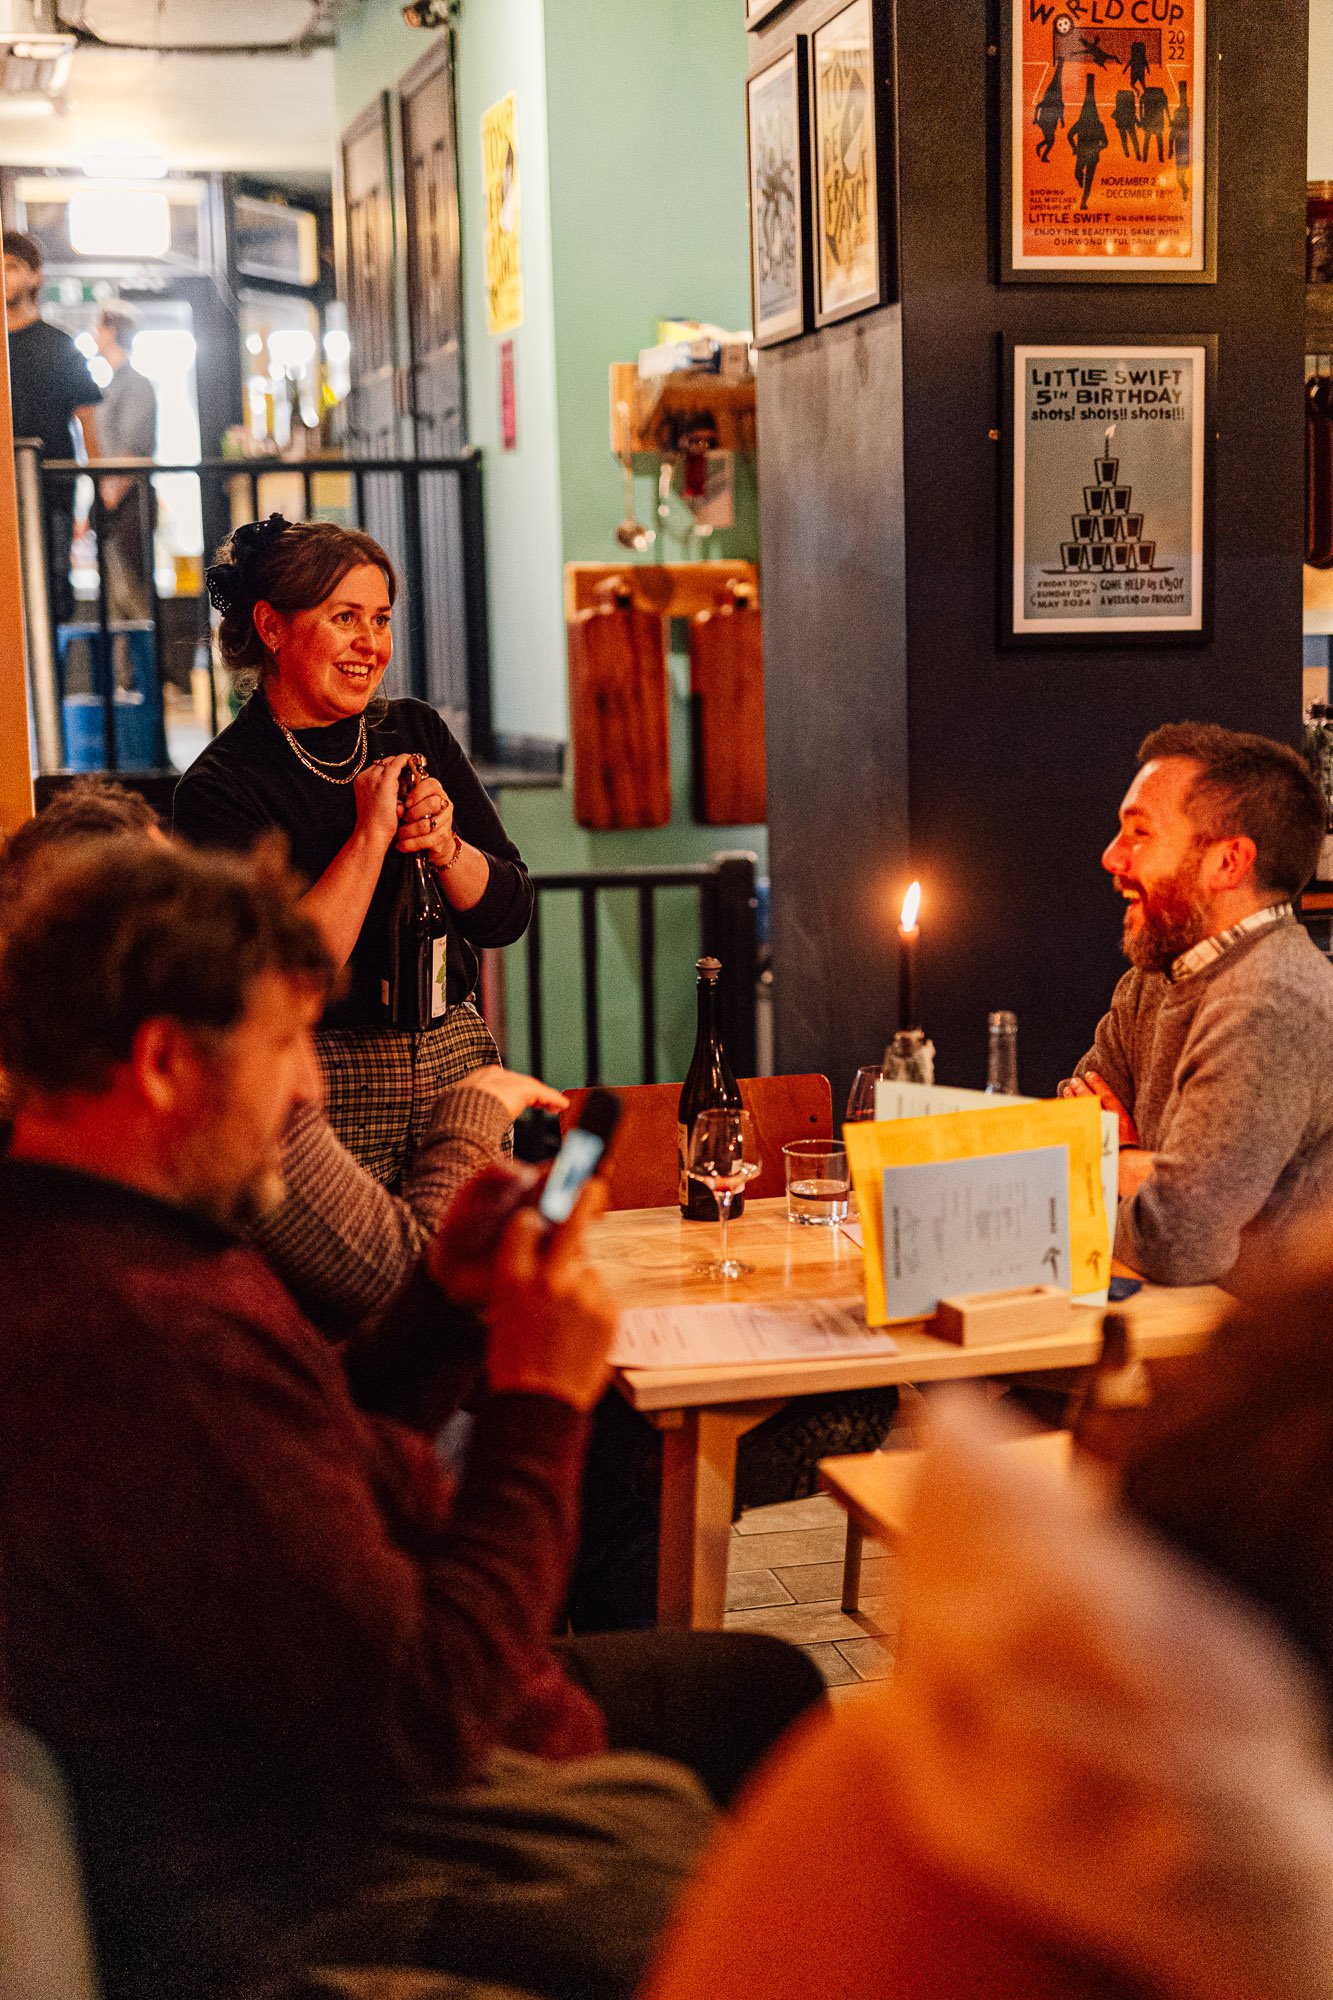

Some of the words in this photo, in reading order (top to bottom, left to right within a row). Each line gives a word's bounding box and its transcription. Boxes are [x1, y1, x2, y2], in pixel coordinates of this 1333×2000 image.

[1131, 0, 1184, 25] CUP
[1168, 31, 1185, 44] 20
[1168, 46, 1185, 60] 22
[1101, 176, 1150, 187] NOVEMBER
[1106, 189, 1153, 199] DECEMBER
[1029, 213, 1069, 223] LITTLE
[1073, 213, 1111, 223] SWIFT
[1034, 228, 1061, 236] ENJOY
[1064, 228, 1079, 236] THE
[1082, 228, 1128, 236] BEAUTIFUL
[1131, 228, 1155, 236] GAME
[1157, 228, 1180, 236] WITH
[1053, 238, 1073, 246] OUR
[1032, 367, 1108, 387] LITTLE
[1114, 369, 1182, 386] SWIFT
[1076, 387, 1183, 405] BIRTHDAY
[1031, 406, 1076, 421] shots!
[1080, 407, 1128, 421] shots!!
[1130, 406, 1185, 421] shots!!!
[1037, 579, 1067, 588] FRIDAY
[1100, 578, 1122, 590] COME
[1124, 577, 1146, 590] HELP
[1159, 576, 1184, 591] ENJOY
[1036, 590, 1071, 598] SUNDAY
[1108, 594, 1140, 604] WEEKEND
[1037, 600, 1059, 608] MAY
[1063, 598, 1091, 607] 2024
